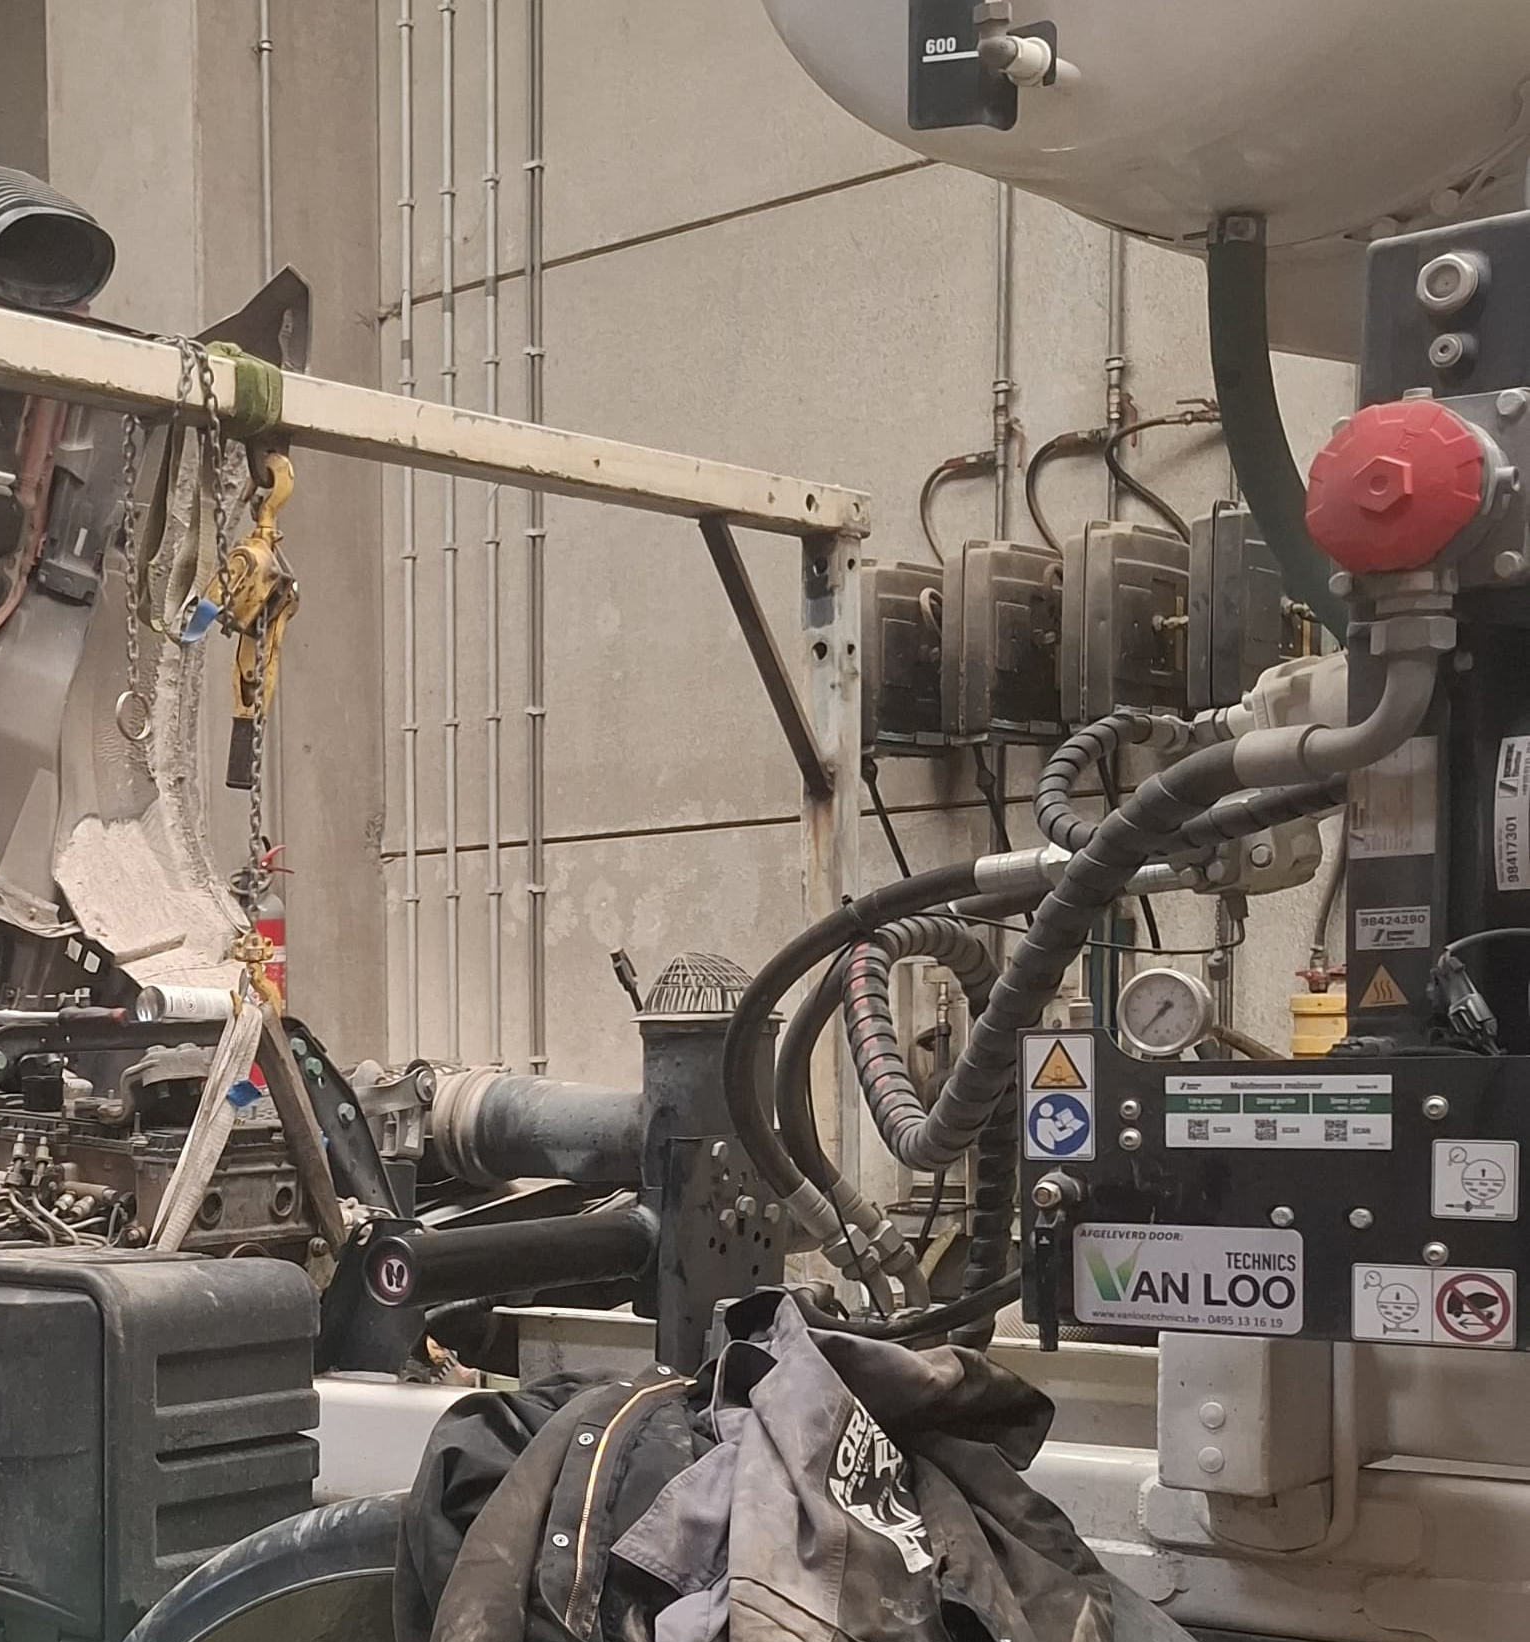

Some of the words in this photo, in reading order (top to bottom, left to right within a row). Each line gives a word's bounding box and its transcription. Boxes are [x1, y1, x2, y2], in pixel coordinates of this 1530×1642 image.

[925, 36, 957, 55] 600
[1079, 1229, 1147, 1241] AFGELEVERD
[1148, 1231, 1184, 1242] DOOR:
[1224, 1251, 1297, 1273] TECHNICS
[1082, 1242, 1190, 1305] VAN
[1203, 1272, 1296, 1310] LOO
[1207, 1314, 1235, 1326] 0495
[1237, 1315, 1251, 1327] 13
[1253, 1316, 1267, 1328] 16
[1270, 1317, 1284, 1329] 19
